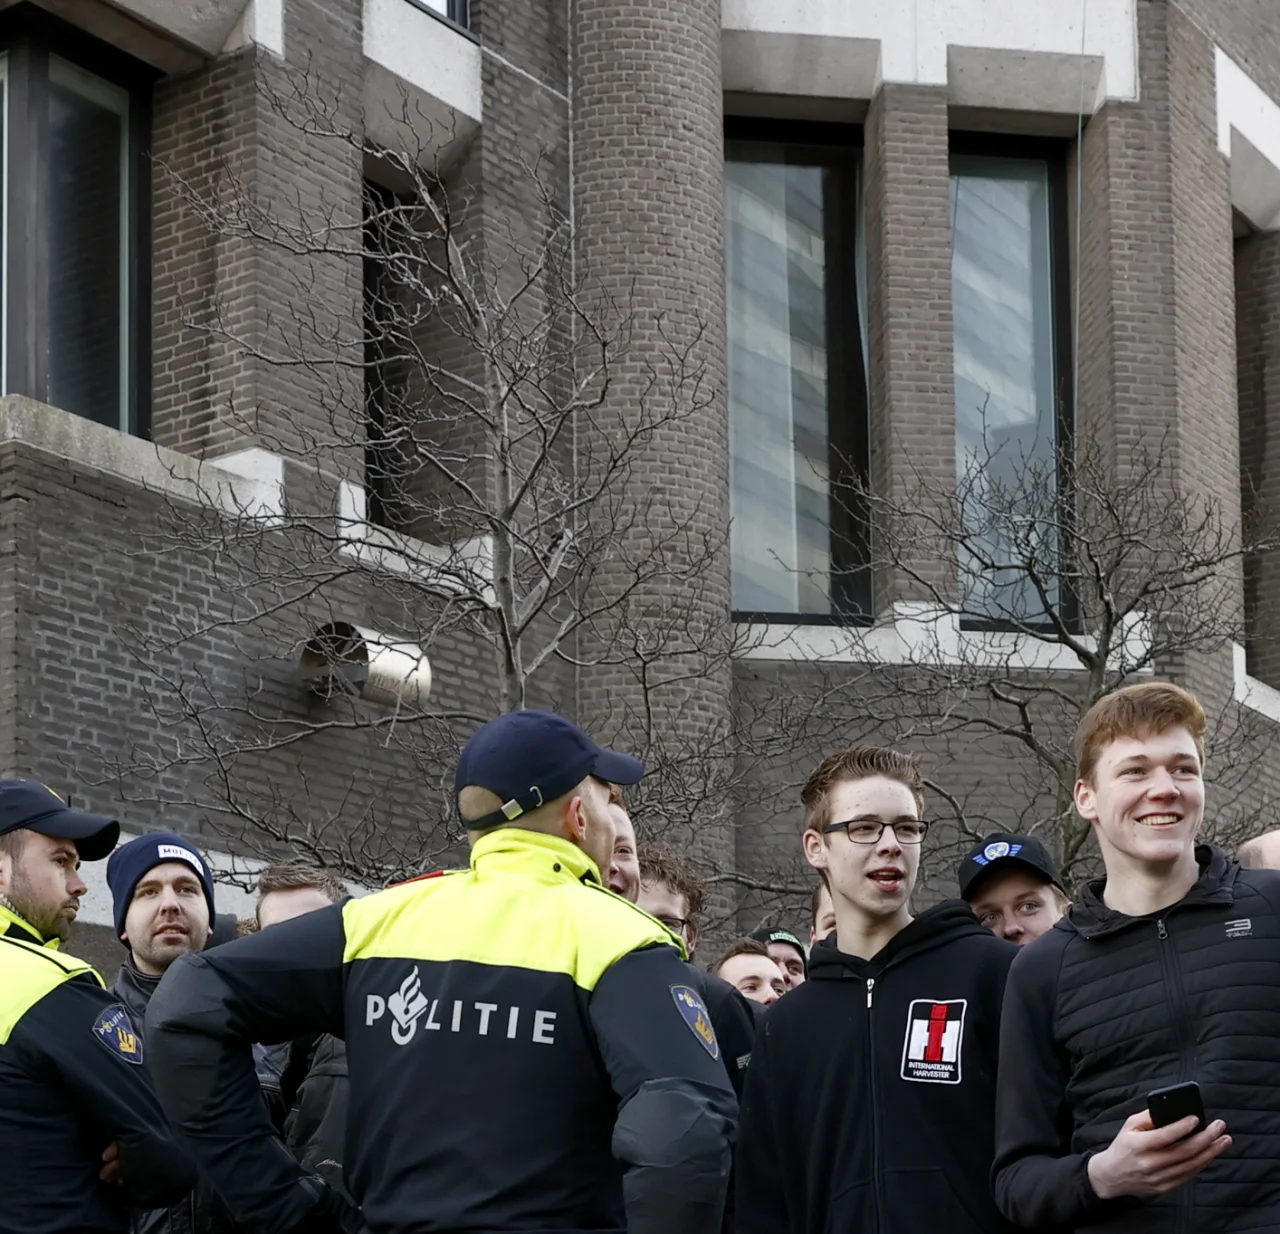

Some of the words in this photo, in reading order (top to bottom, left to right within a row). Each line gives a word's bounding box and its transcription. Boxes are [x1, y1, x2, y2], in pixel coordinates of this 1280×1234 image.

[365, 978, 557, 1046] POLITIE
[908, 1061, 955, 1072] INTERNATIONAL
[912, 1069, 950, 1079] HARVESTER
